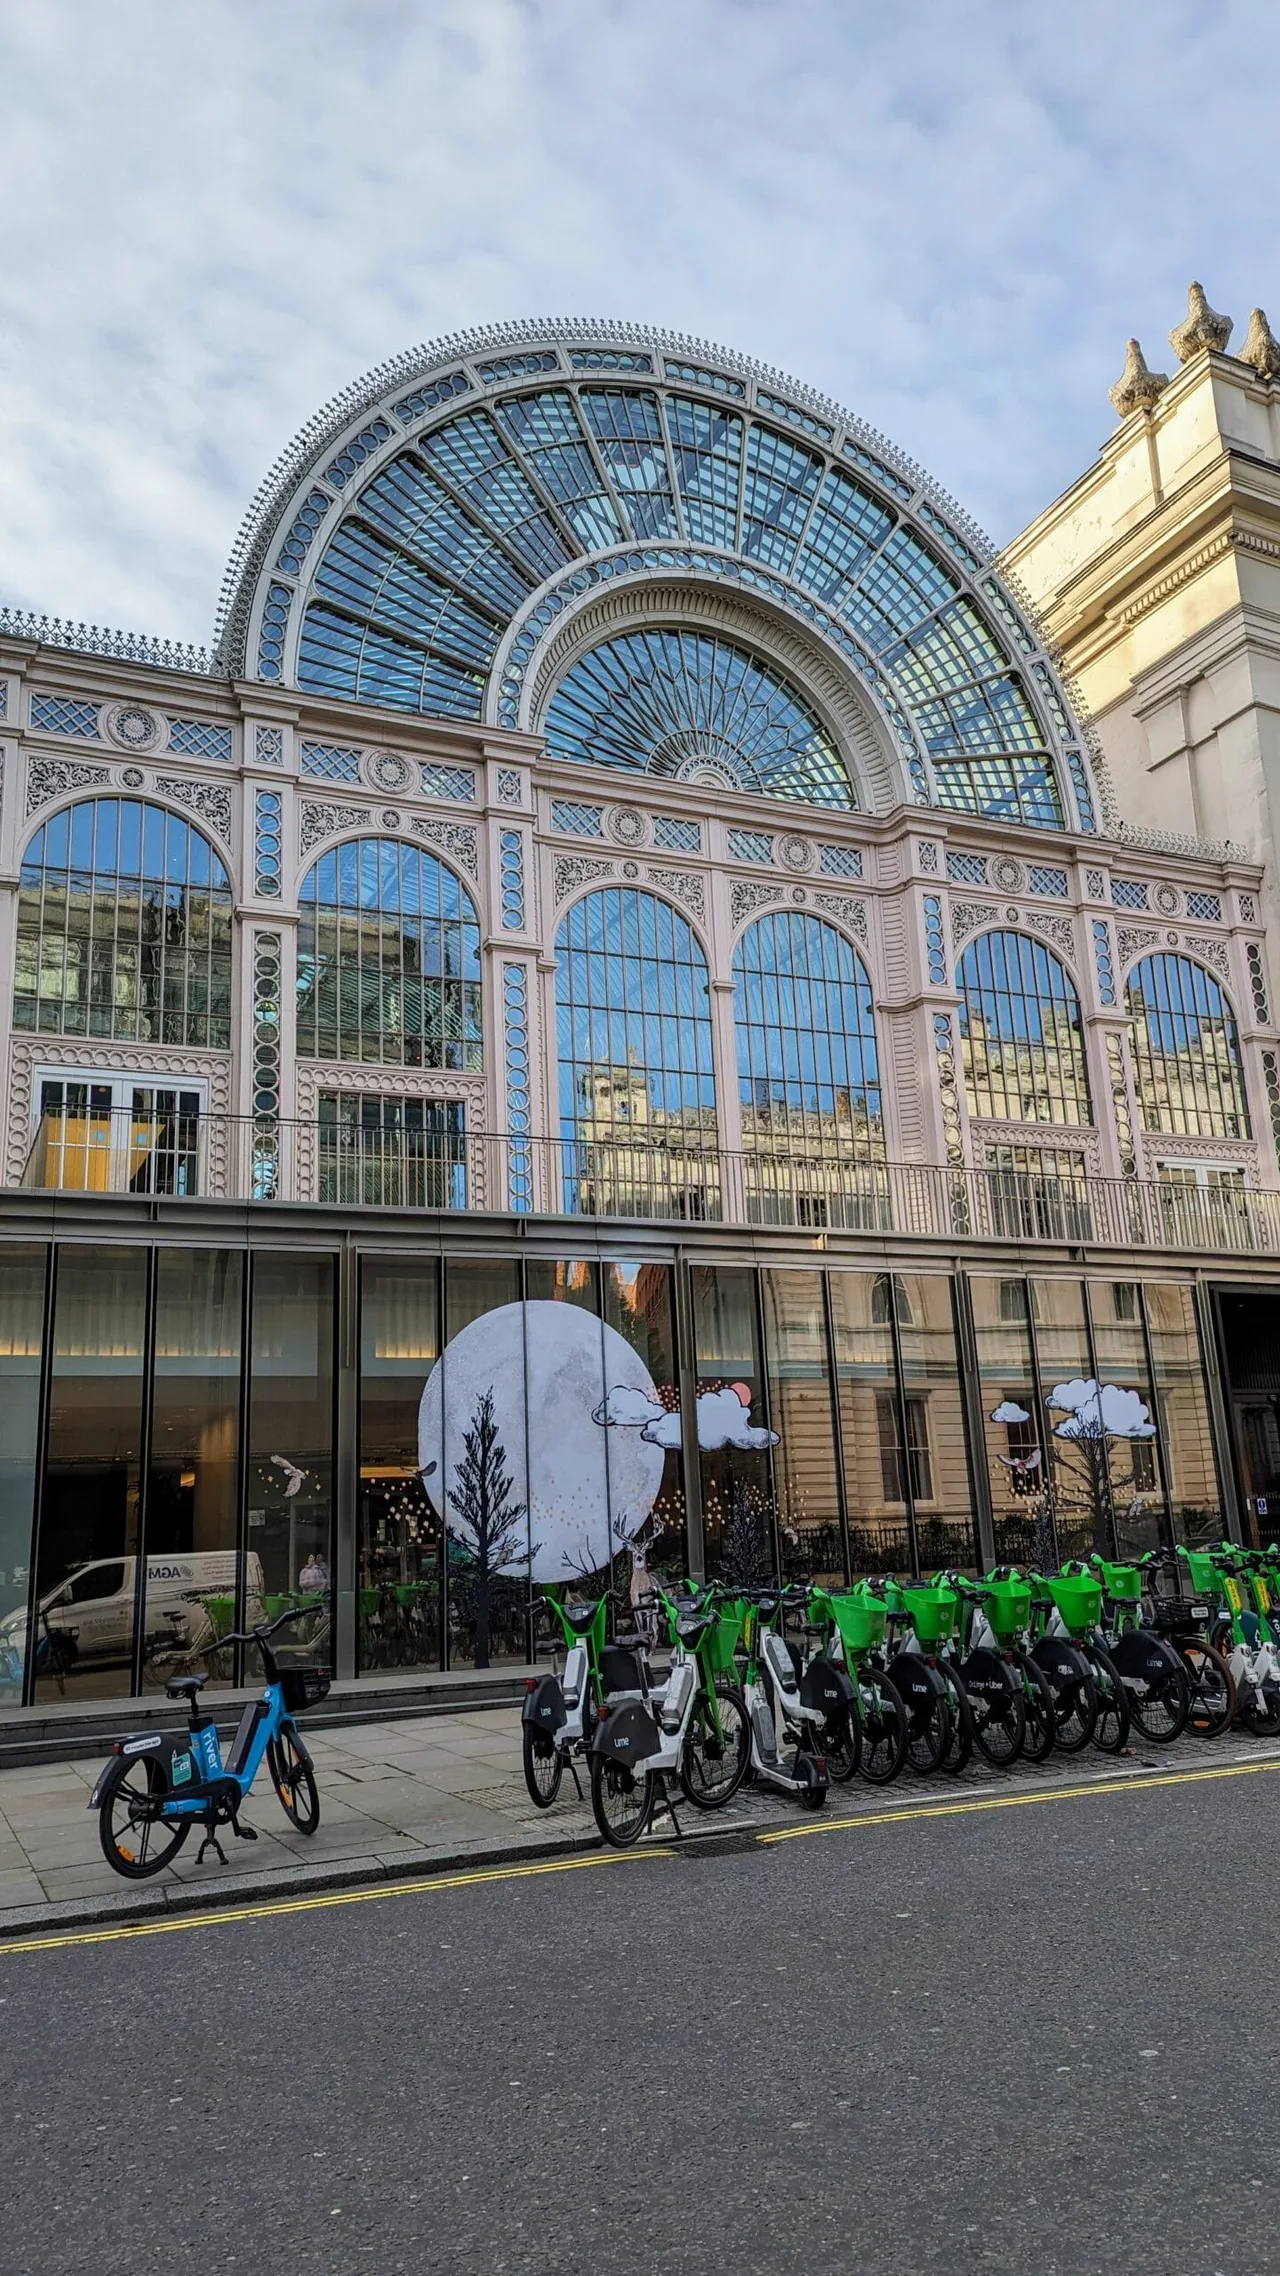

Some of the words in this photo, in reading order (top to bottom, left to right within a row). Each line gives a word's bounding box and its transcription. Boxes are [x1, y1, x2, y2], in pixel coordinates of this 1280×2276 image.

[1146, 1659, 1163, 1668] Lime
[824, 1688, 838, 1698] Lime
[912, 1683, 928, 1693] Lime
[540, 1707, 552, 1717] Lime
[614, 1737, 630, 1748] Lime
[203, 1731, 218, 1769] river
